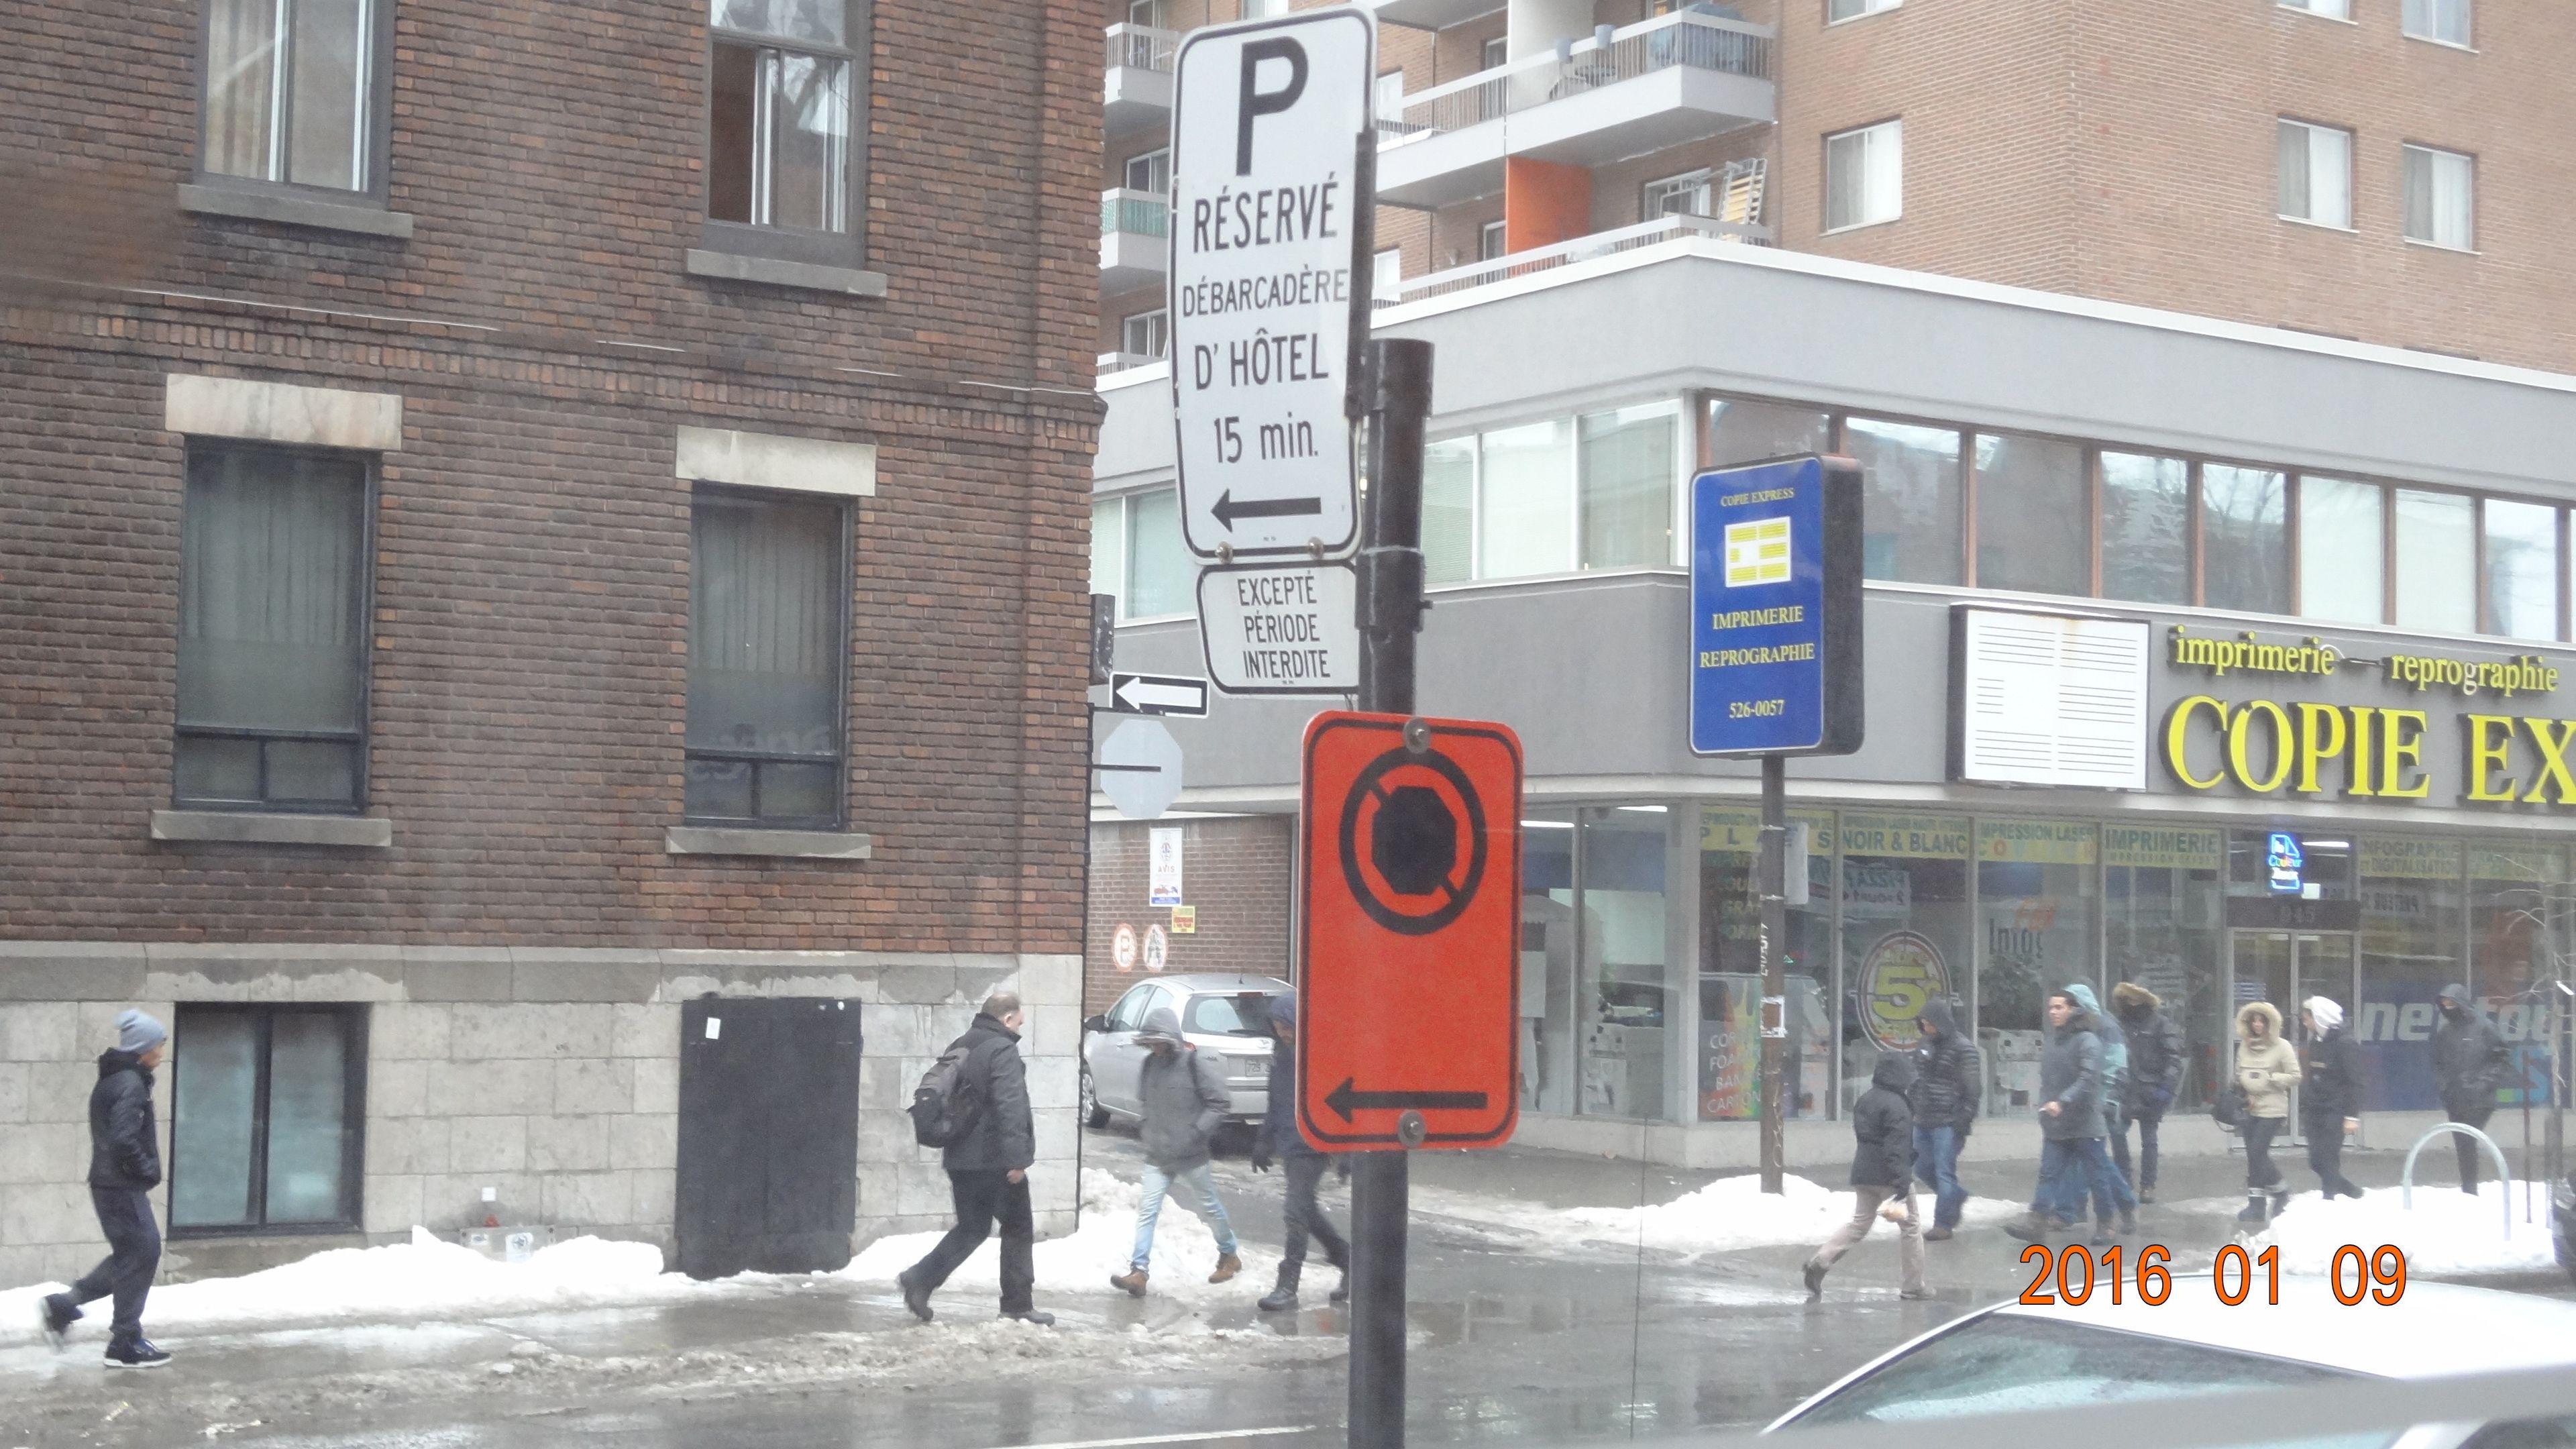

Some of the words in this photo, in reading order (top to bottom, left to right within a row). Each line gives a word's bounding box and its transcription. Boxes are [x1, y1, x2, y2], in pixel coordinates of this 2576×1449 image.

[1236, 36, 1309, 176] P
[1193, 172, 1338, 254] RÉSERVÉ
[1183, 264, 1349, 317] DÉBARCADÈRE
[1230, 328, 1328, 387] HÔTEL
[1214, 416, 1242, 464] 15
[1260, 412, 1320, 460] min.
[1721, 493, 1750, 507] COPIE
[1752, 488, 1794, 504] EXPRESS
[1244, 609, 1320, 643] PÉRIODE
[1712, 606, 1804, 630] IMPRIMERIE
[1242, 649, 1331, 680] INTERDITE
[1700, 643, 1815, 668] REPROGRAPHIE
[2175, 624, 2335, 676] imprimerie
[2392, 655, 2558, 697] reprographie
[1729, 699, 1785, 719] 526-0057
[2167, 695, 2430, 798] COPIE
[1843, 830, 1886, 850] NOIR
[1909, 833, 1968, 855] BLANC
[1980, 822, 2053, 841] MPRESSION
[2105, 828, 2218, 853] IMPRIMERIE
[1158, 865, 1175, 873] AVIS
